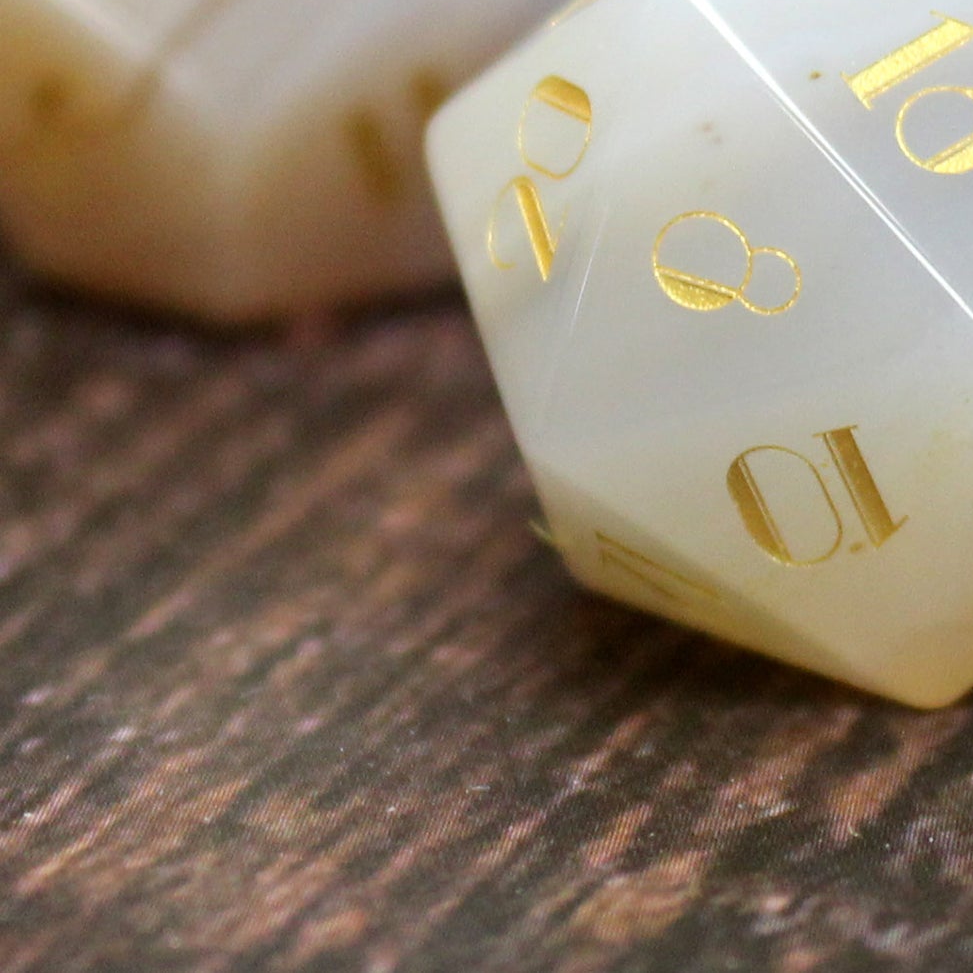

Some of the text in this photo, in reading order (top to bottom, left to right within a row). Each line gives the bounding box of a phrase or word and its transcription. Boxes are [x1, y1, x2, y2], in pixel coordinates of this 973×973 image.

[487, 74, 593, 283] 20
[652, 210, 802, 315] 8
[726, 424, 909, 567] 10
